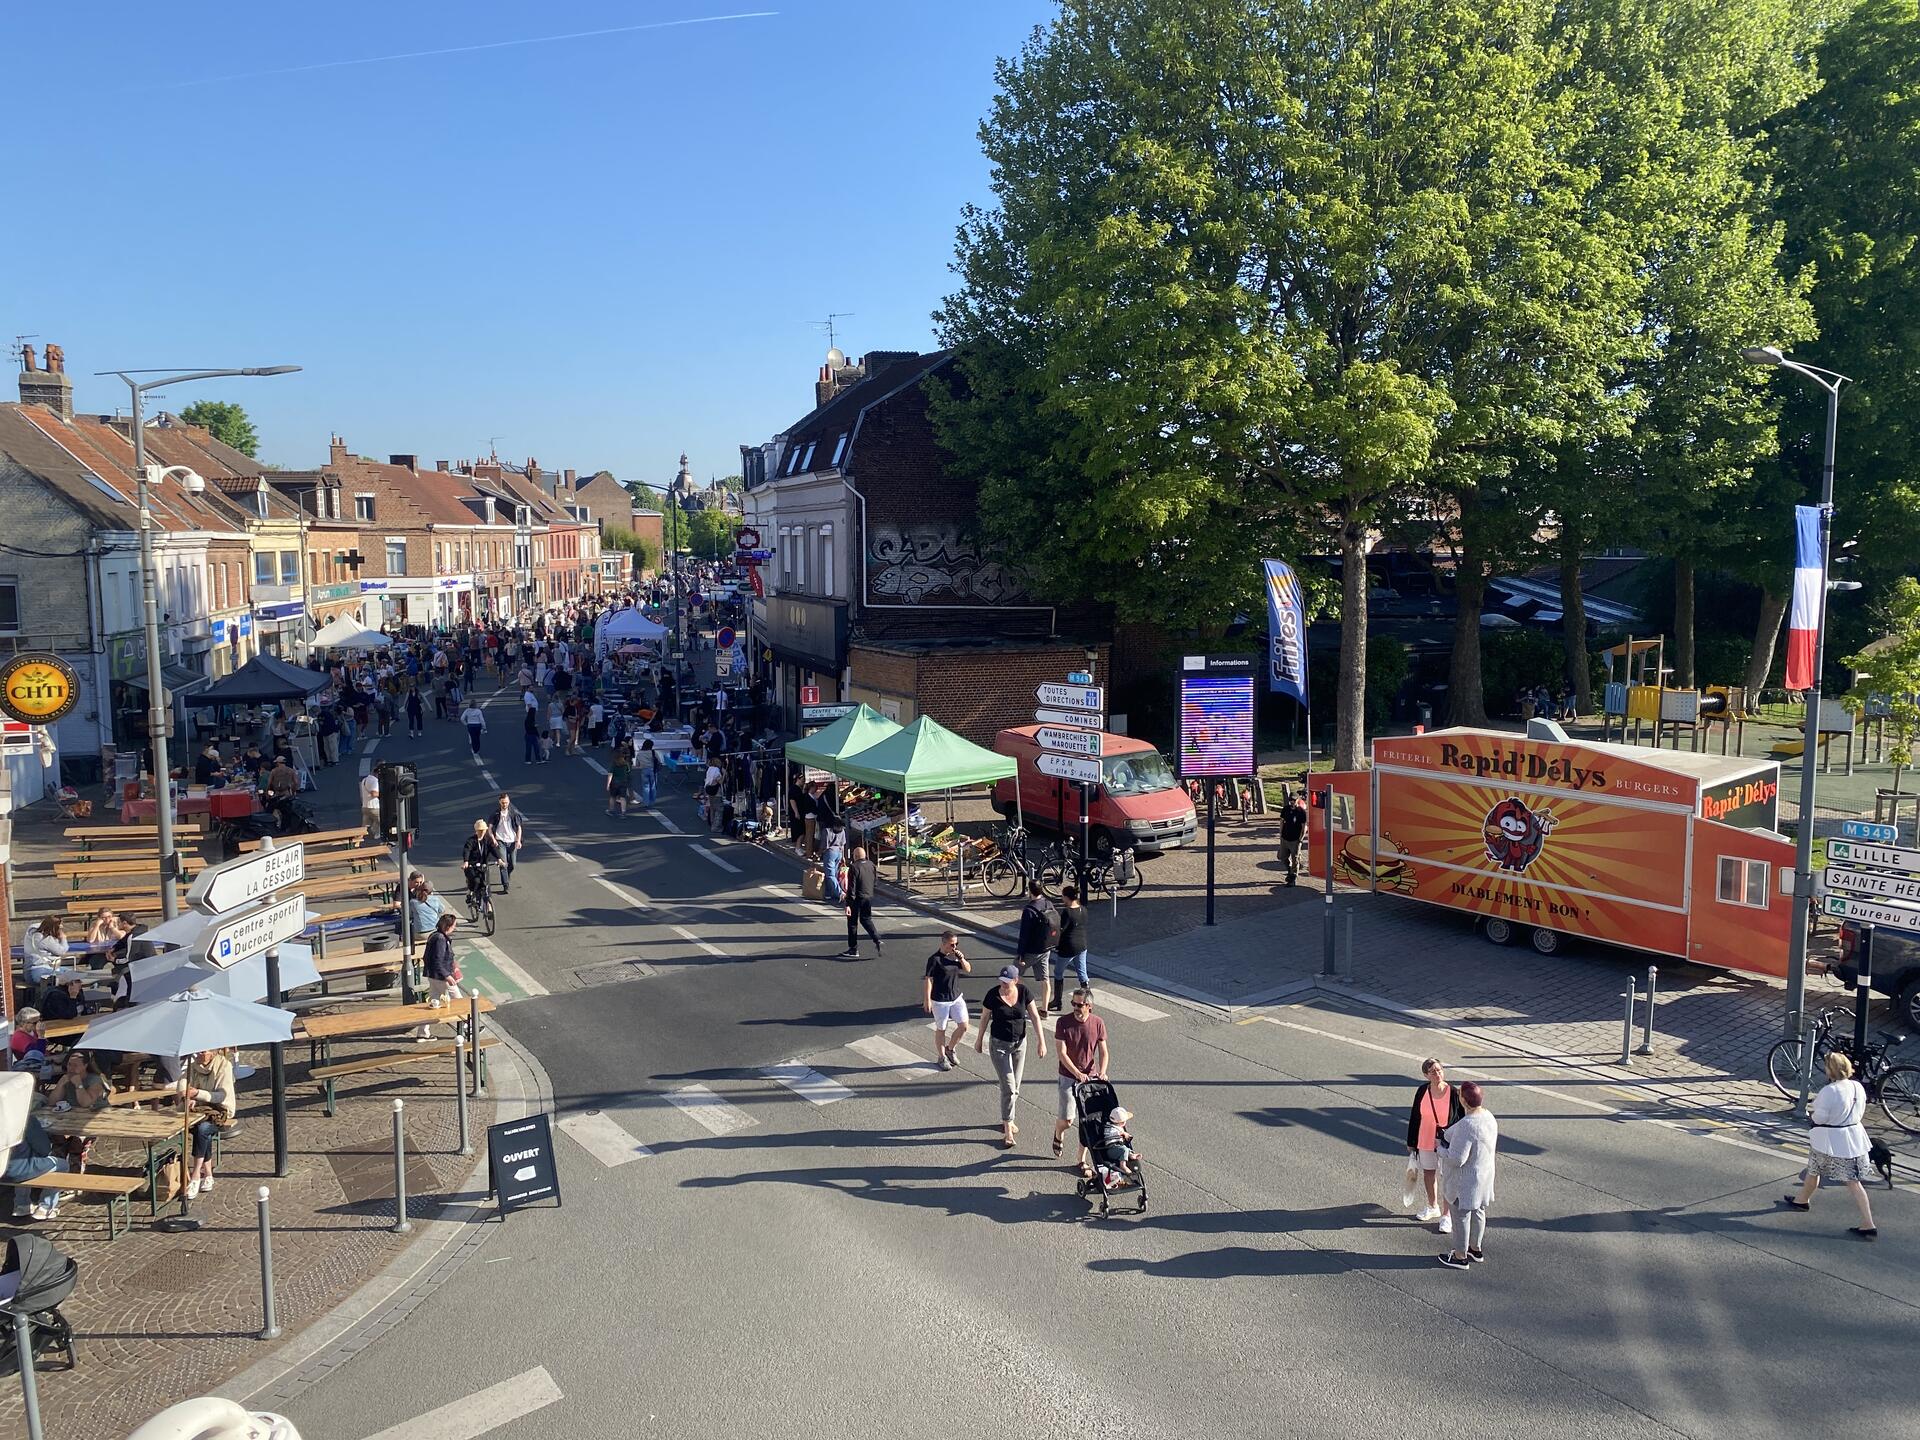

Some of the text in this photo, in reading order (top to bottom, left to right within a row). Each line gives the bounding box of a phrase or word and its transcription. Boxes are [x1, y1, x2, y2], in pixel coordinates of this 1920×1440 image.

[1271, 609, 1300, 684] Frites
[1043, 686, 1068, 696] TOUTES
[1064, 715, 1098, 726] COMINES
[1043, 730, 1088, 742] WAMBRECHIES
[1079, 770, 1098, 780] André
[1383, 743, 1680, 796] FRITERIE Rapid'Délys BURGERS
[1847, 824, 1891, 839] M 949
[265, 849, 299, 873] BEL-AIR
[1854, 848, 1901, 865] LILLE
[246, 864, 300, 896] LA CESSOIE
[1832, 873, 1888, 892] SAINTE
[1451, 882, 1543, 912] DIABLEMENT
[1549, 902, 1579, 920] BON
[233, 899, 300, 940] centre sportif
[1850, 904, 1920, 926] bureau d
[234, 929, 274, 956] Ducrocq
[502, 1147, 540, 1164] OUVERT
